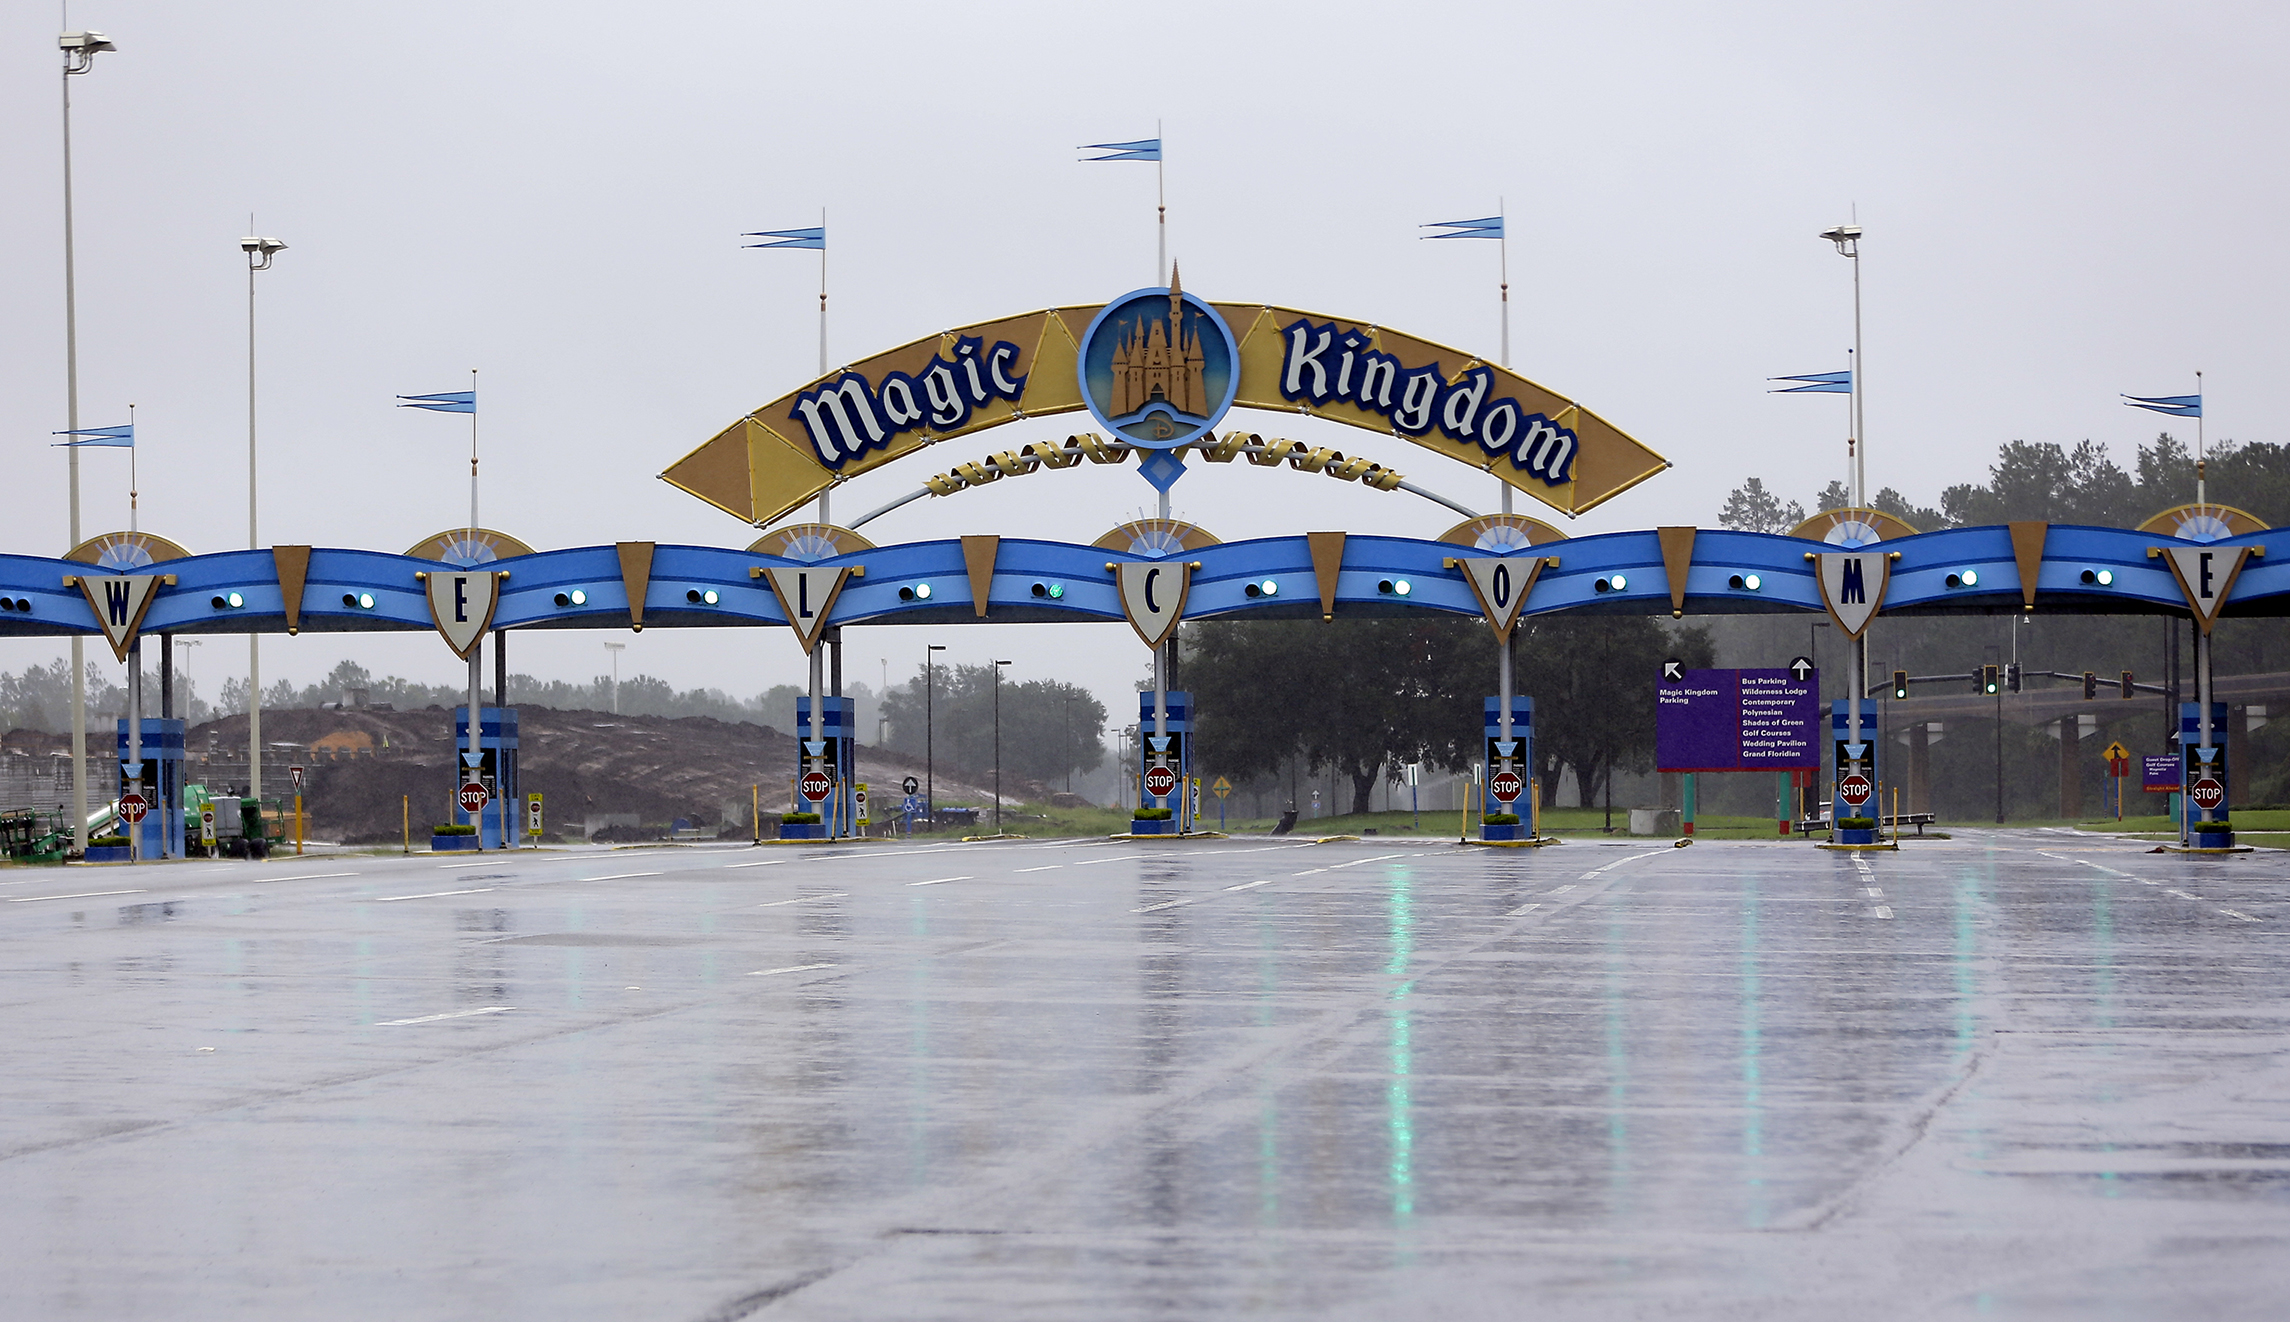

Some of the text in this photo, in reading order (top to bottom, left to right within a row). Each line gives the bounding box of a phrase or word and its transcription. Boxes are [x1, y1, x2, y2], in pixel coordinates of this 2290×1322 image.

[798, 327, 1572, 479] Magic Kingdom
[104, 552, 2213, 627] W E L C O M E
[1757, 678, 1787, 686] Parking
[1660, 688, 1718, 697] Magic Kingdom
[1784, 688, 1808, 696] Lodge
[1660, 697, 1689, 705] Parking
[1742, 709, 1783, 717] Polynesian
[1742, 740, 1775, 748] Wedding
[803, 781, 829, 793] STOP
[1147, 775, 1173, 788] STOP
[1494, 781, 1520, 793] STOP
[1842, 784, 1869, 796] STOP
[2194, 788, 2221, 800] STOP
[120, 802, 146, 815] STOP
